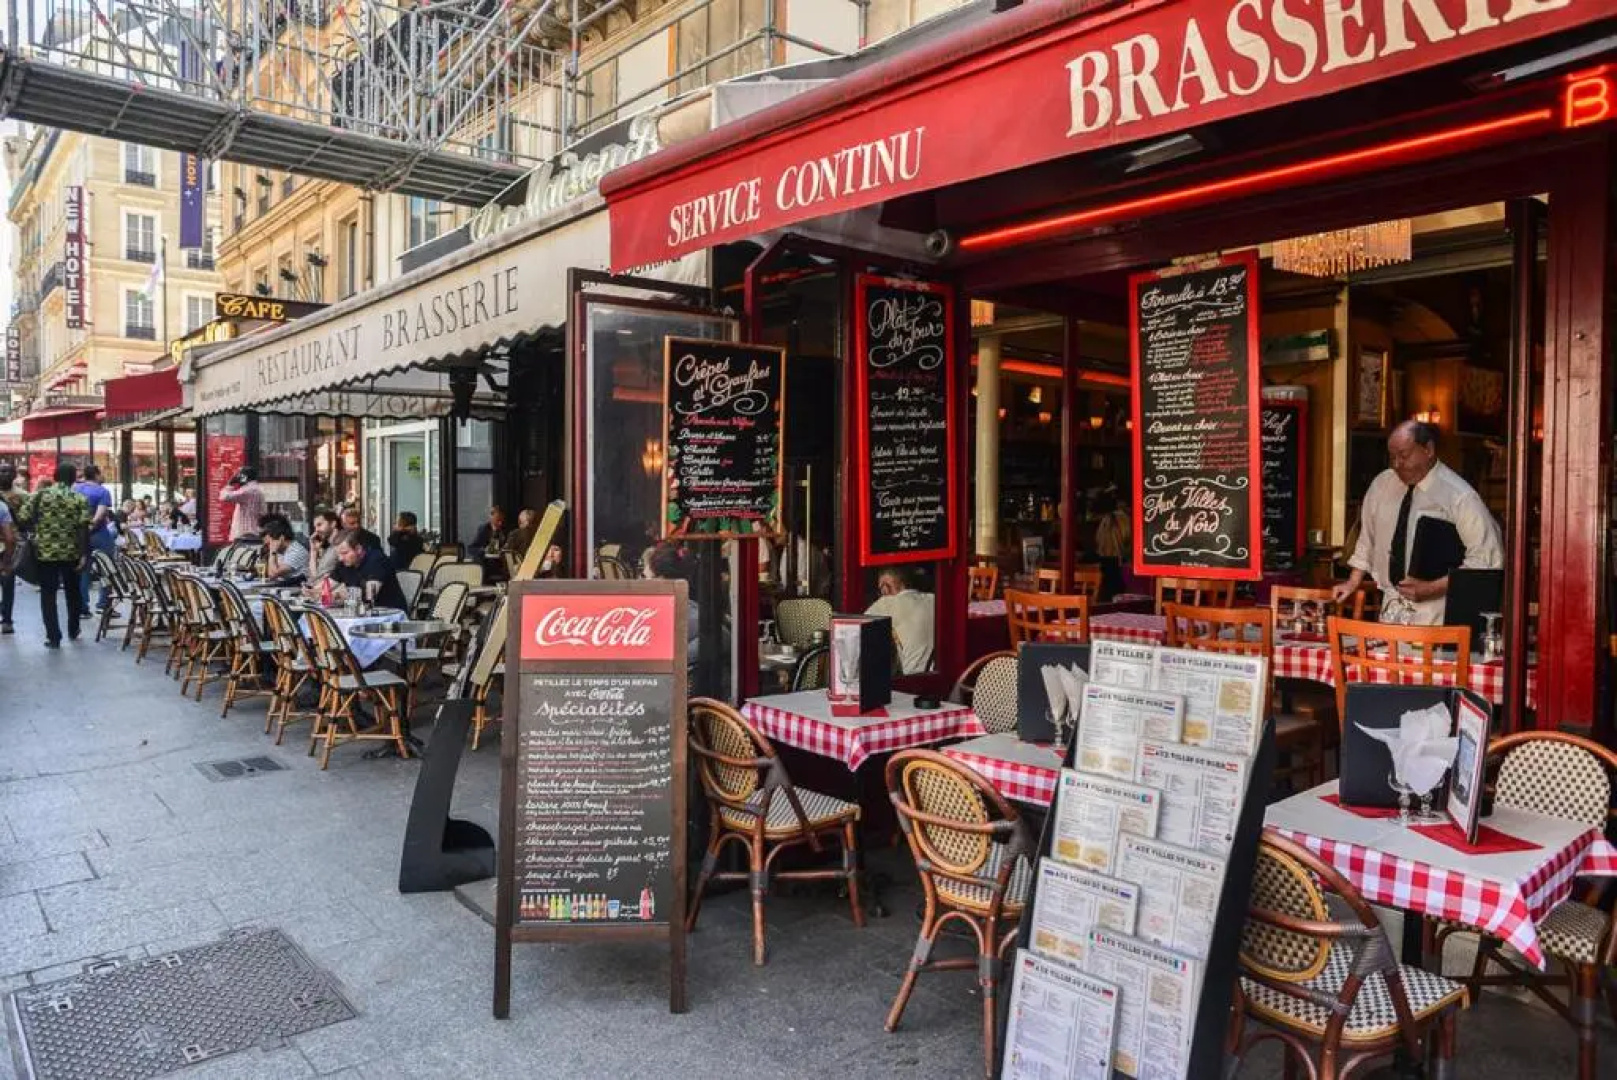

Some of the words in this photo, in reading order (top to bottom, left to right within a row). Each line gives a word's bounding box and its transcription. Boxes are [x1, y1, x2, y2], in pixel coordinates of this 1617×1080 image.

[1063, 0, 1570, 137] BRASSER
[667, 177, 761, 247] SERVICE
[776, 126, 925, 211] CONTINU
[66, 243, 80, 320] HOTEL
[257, 324, 363, 387] RESTAURANT
[383, 265, 519, 351] BRASSERIE
[535, 700, 645, 722] Spécialités
[583, 678, 609, 686] TEMPS
[631, 678, 658, 686] REPAS
